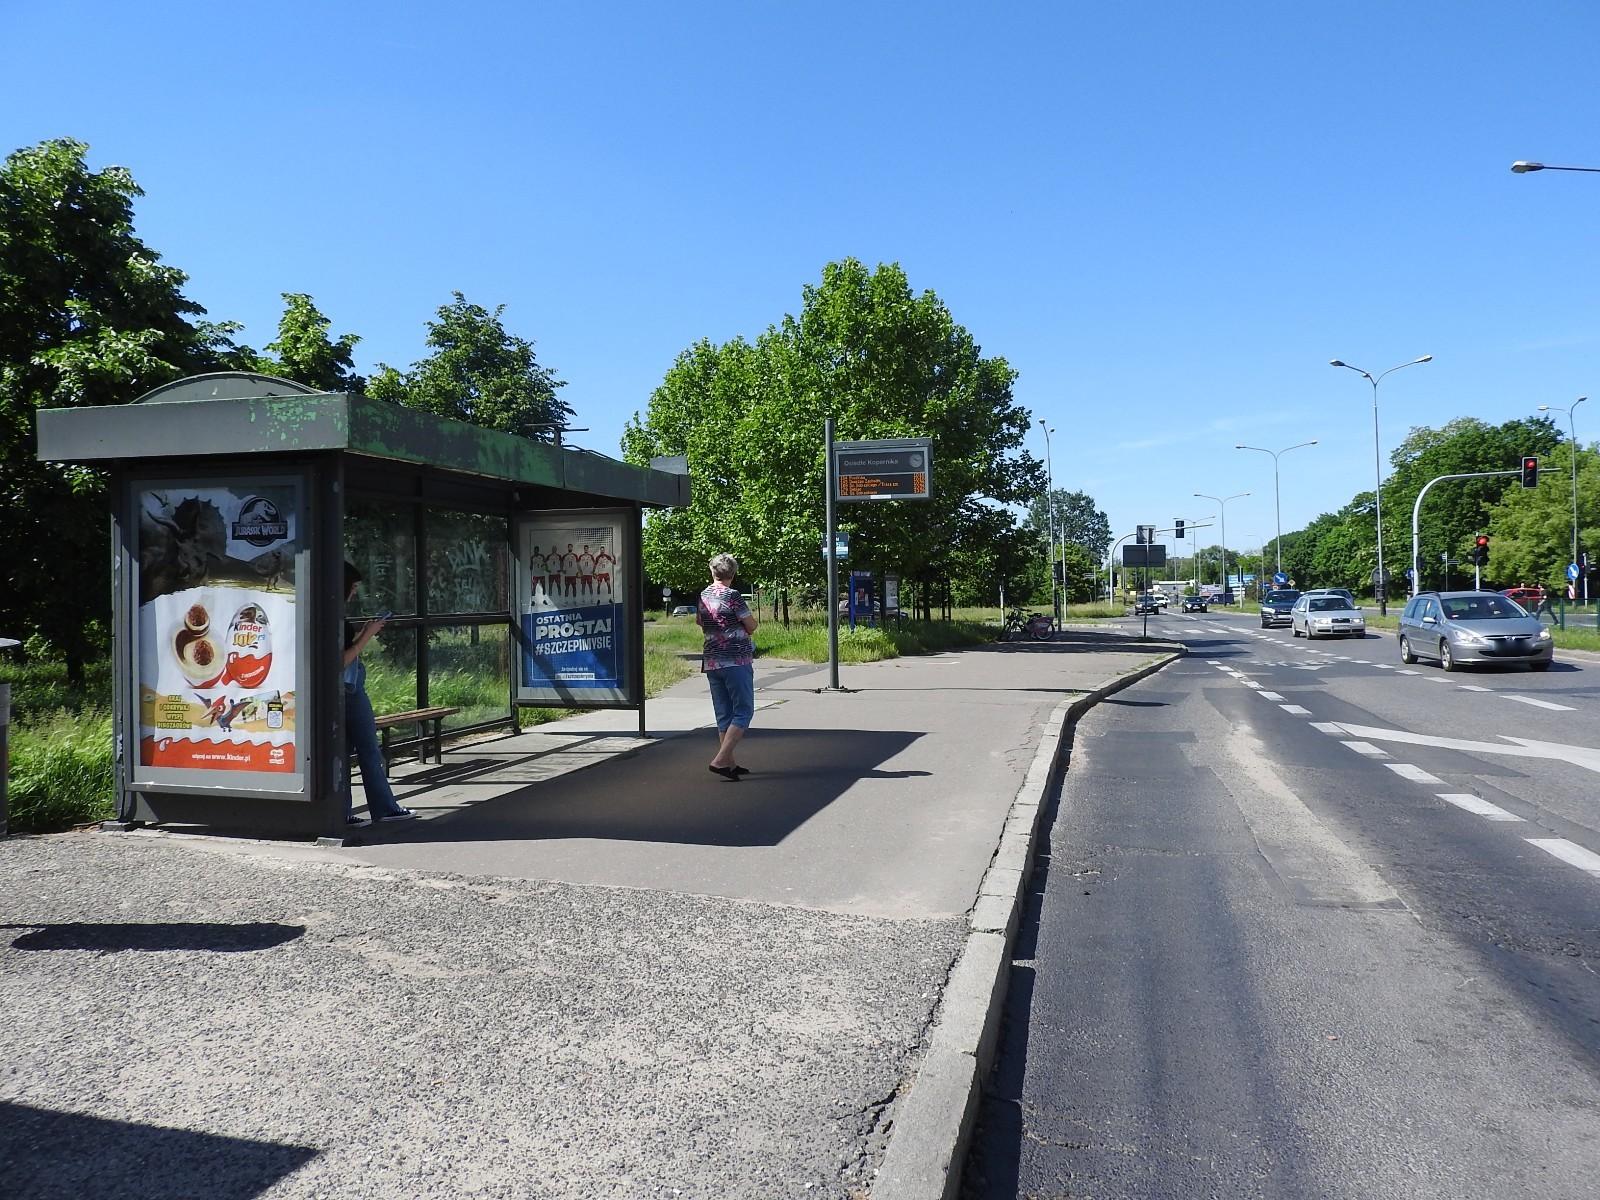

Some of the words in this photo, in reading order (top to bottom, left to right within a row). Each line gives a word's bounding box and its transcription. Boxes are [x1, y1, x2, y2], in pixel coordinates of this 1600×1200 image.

[235, 526, 260, 537] JURASSIC
[261, 525, 286, 536] WORLD
[536, 613, 583, 625] OSTATNIA
[535, 618, 612, 641] PROSTA!
[535, 636, 612, 656] #SZCZEPIMYSIĘ
